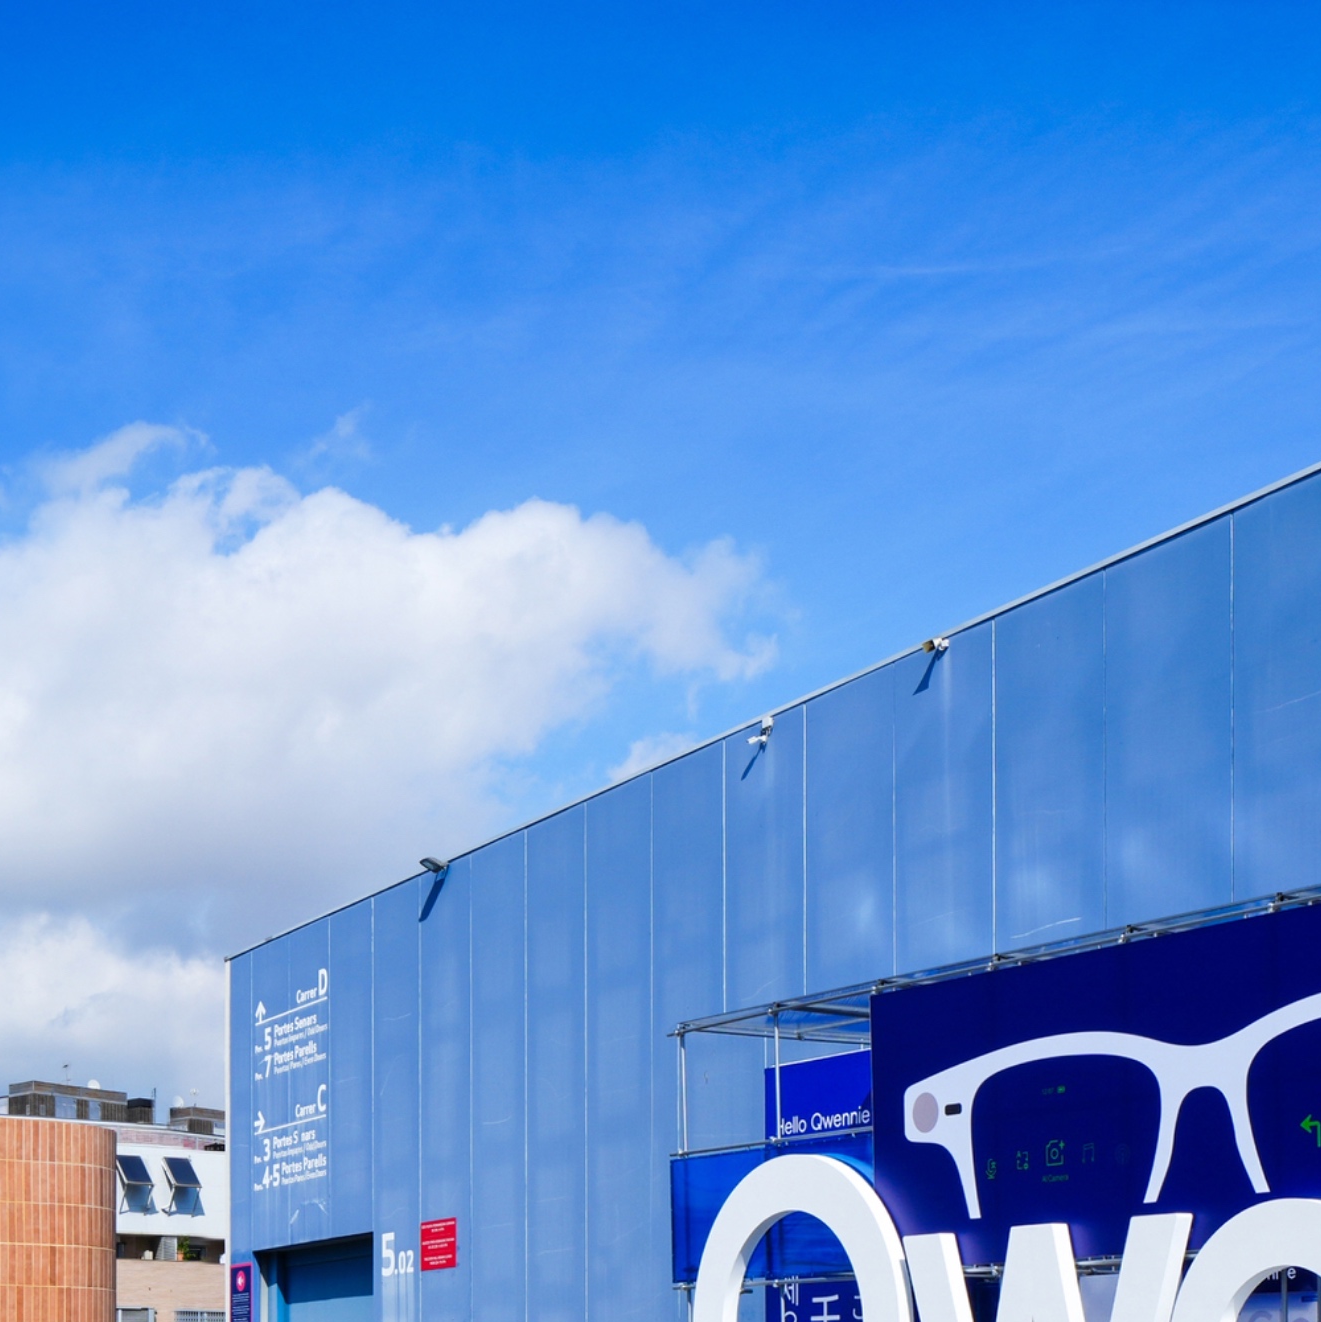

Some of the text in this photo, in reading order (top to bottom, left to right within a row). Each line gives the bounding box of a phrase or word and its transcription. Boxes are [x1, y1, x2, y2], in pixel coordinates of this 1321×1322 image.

[296, 968, 328, 1004] Carrer D
[264, 1026, 272, 1051] 5
[264, 1055, 273, 1078] 7
[295, 1084, 327, 1118] Carrer C
[810, 1105, 871, 1131] Qwennie
[263, 1138, 271, 1162] 3
[382, 1232, 414, 1277] 5.02
